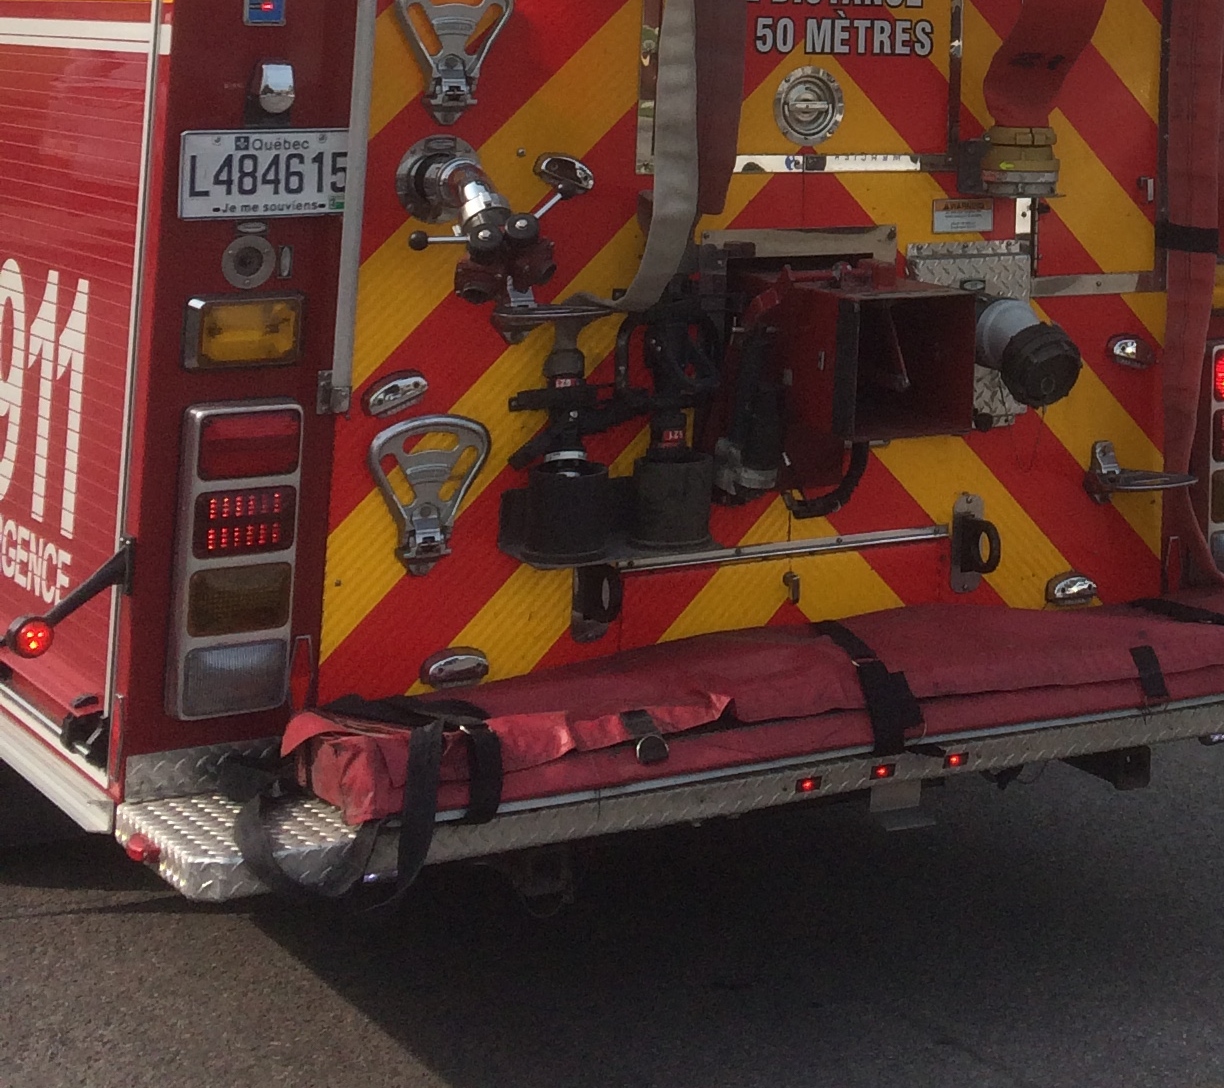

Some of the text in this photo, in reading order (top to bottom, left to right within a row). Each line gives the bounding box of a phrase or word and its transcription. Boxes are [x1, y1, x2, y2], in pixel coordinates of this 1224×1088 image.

[754, 8, 935, 58] 50 MÈTRES
[251, 137, 310, 151] Québec
[188, 151, 348, 198] L484615
[221, 202, 237, 213] Je
[240, 204, 260, 213] me
[262, 200, 319, 212] souviens
[0, 258, 90, 540] 911
[0, 513, 73, 607] GENCE
